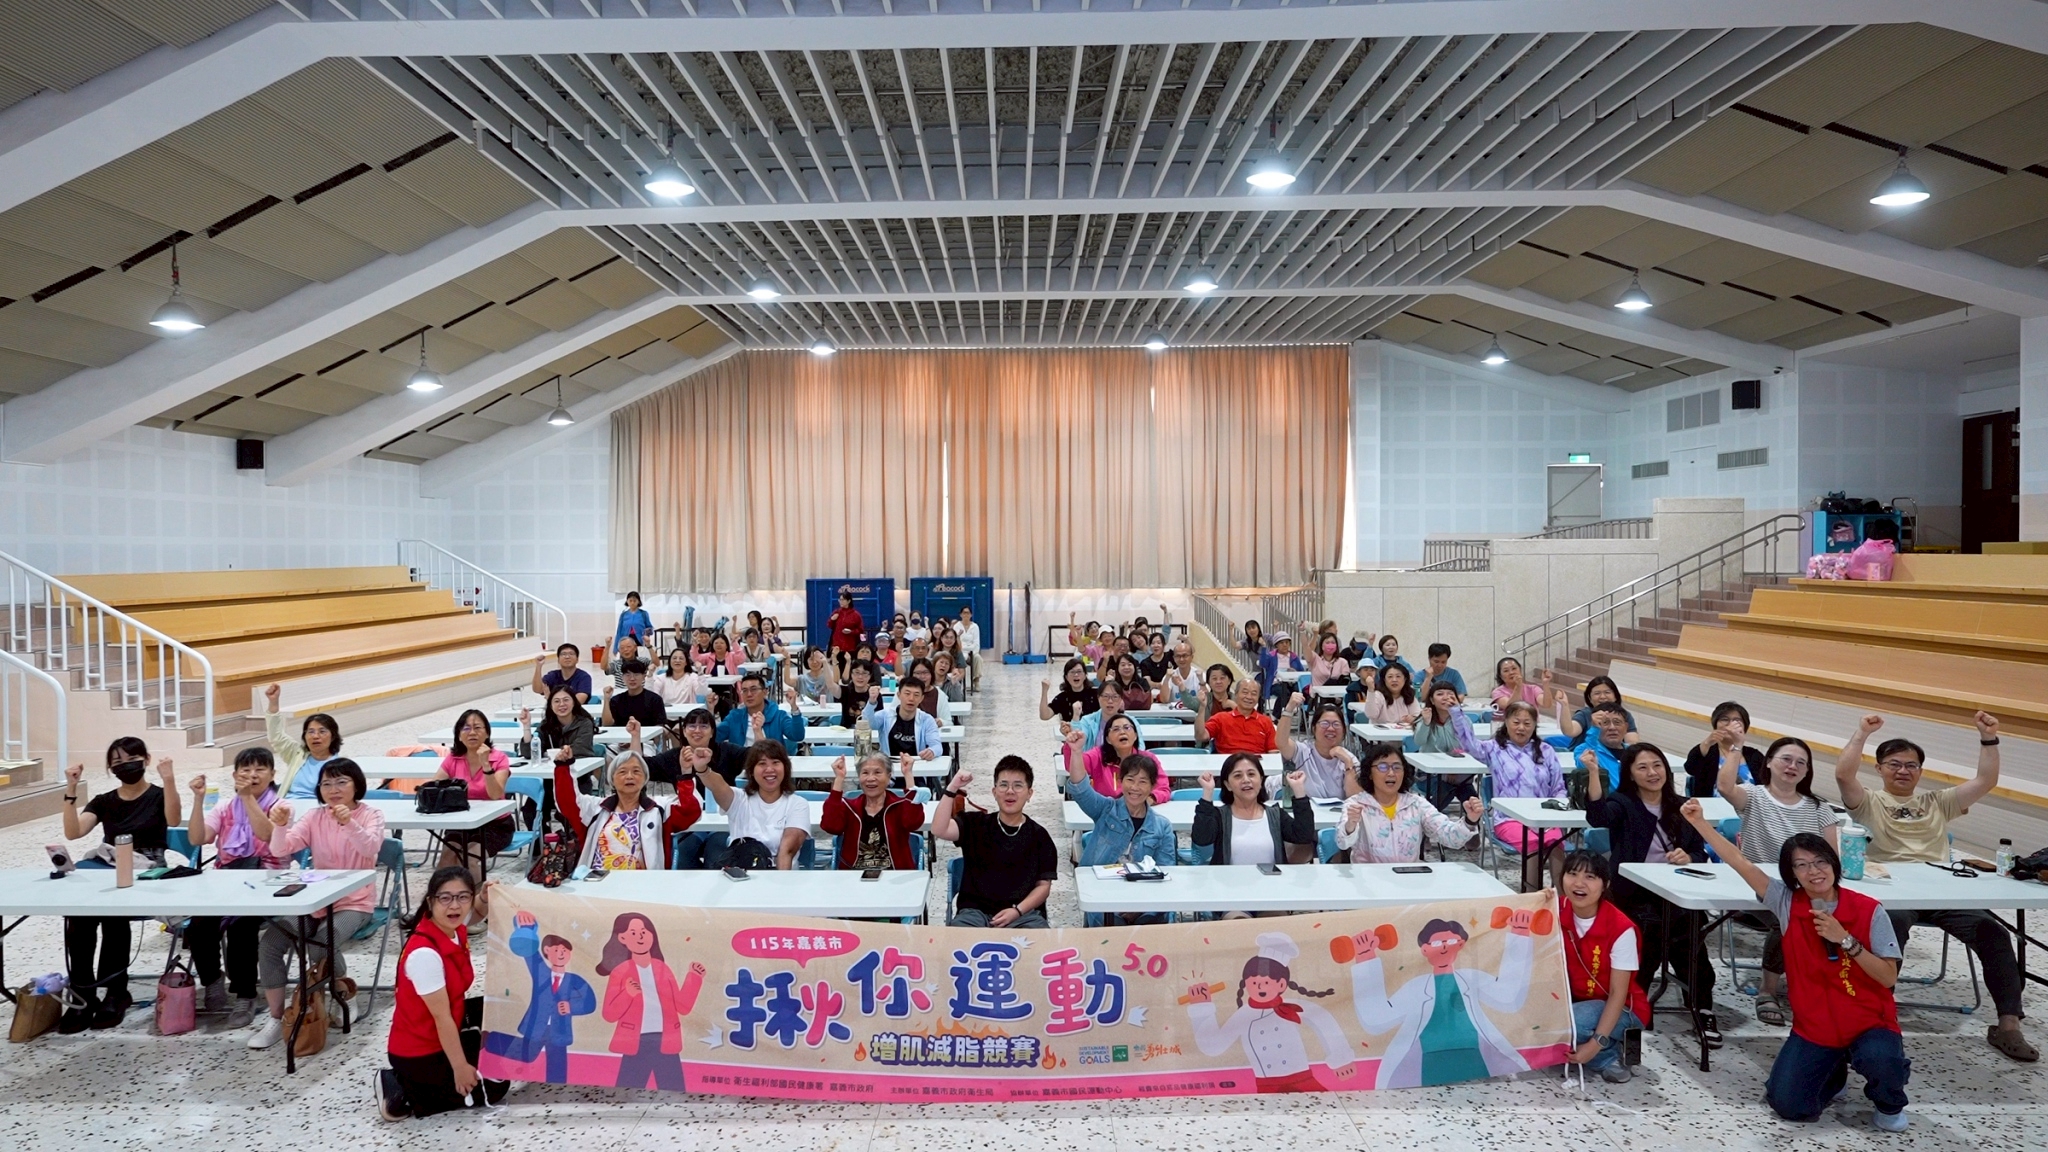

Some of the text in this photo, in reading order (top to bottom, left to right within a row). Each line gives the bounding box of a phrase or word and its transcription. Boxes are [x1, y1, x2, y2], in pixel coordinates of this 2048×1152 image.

[750, 935, 842, 951] 115年嘉義市
[725, 942, 1168, 1048] 揪你運動 5.0
[871, 1033, 1037, 1065] 增肌減脂競賽
[1079, 1055, 1111, 1064] GOALS
[829, 1083, 874, 1093] 嘉義市政府
[922, 1086, 994, 1096] 嘉義市政府衛生局
[1042, 1086, 1123, 1096] 嘉義市國民運動中心
